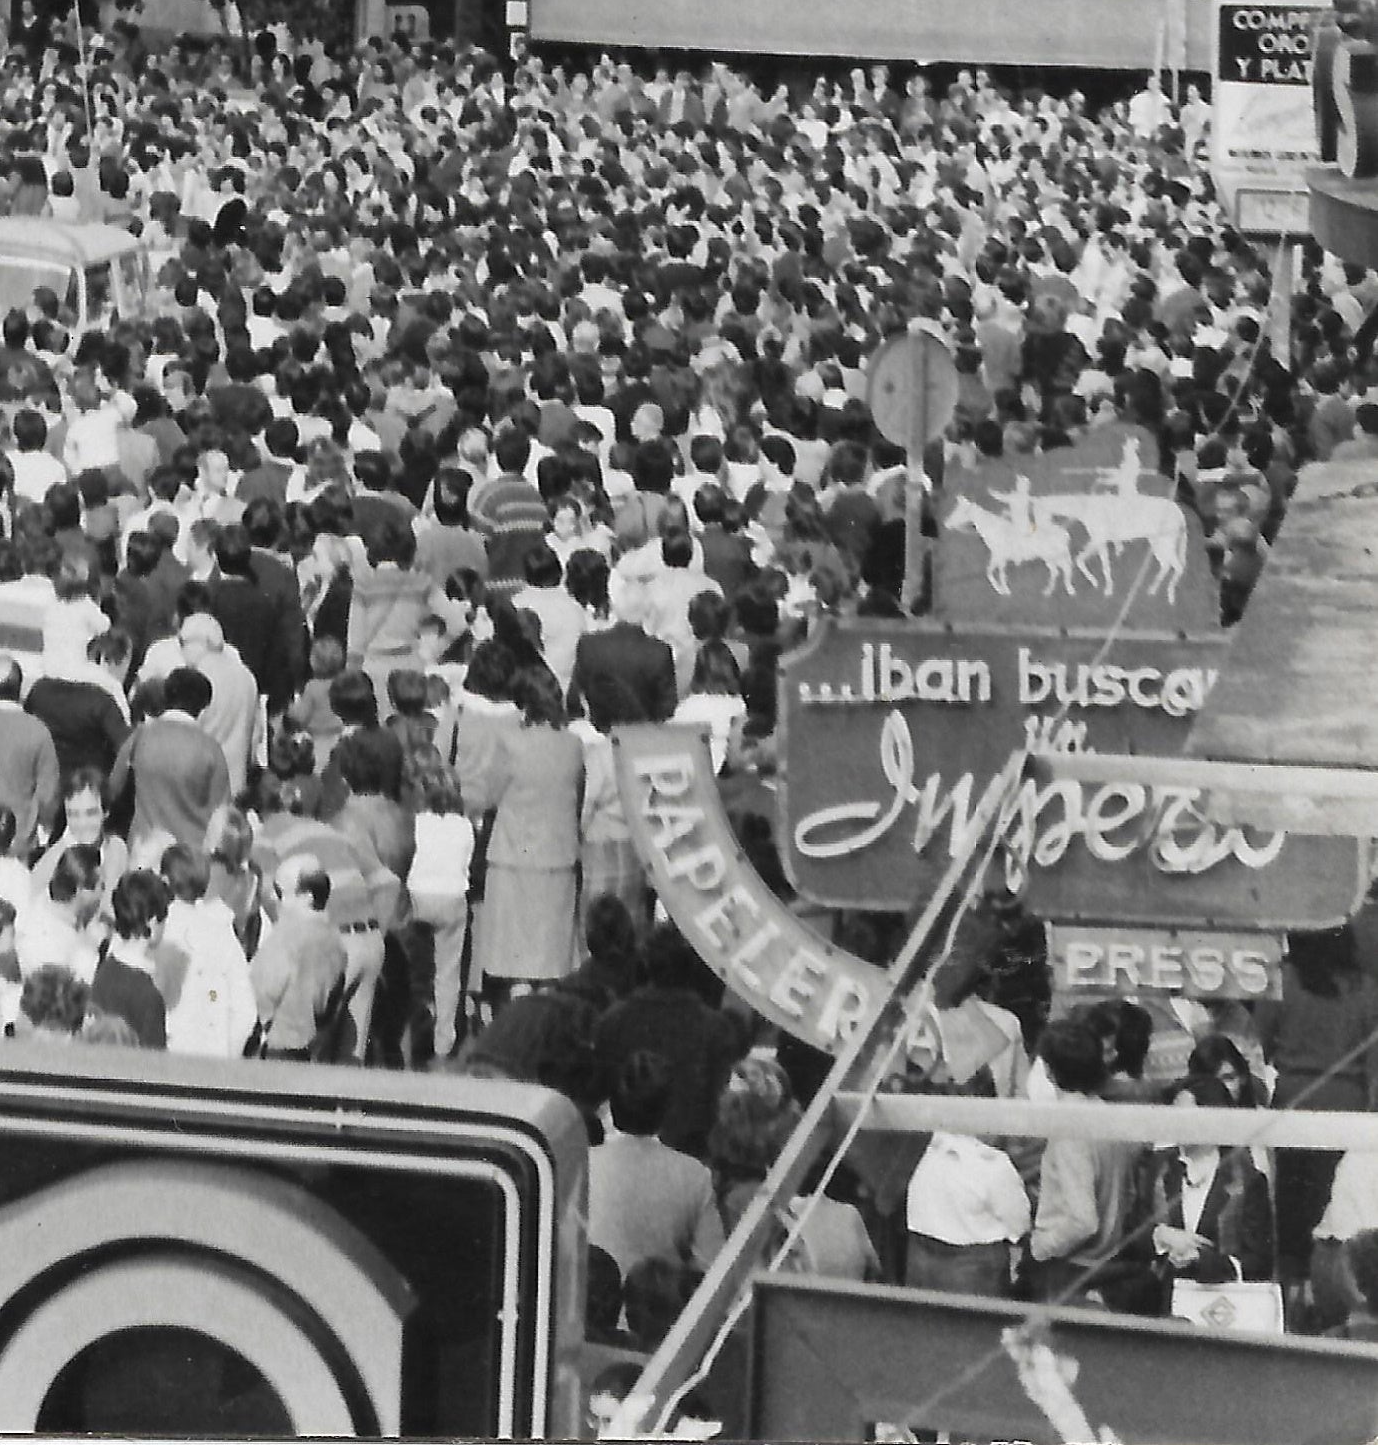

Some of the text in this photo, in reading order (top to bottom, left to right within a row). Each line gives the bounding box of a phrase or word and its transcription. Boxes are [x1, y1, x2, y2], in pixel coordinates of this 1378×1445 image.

[1257, 33, 1310, 55] ORO
[1235, 57, 1253, 80] Y
[632, 753, 945, 1065] PAPELERA
[1065, 942, 1270, 994] PRESS
